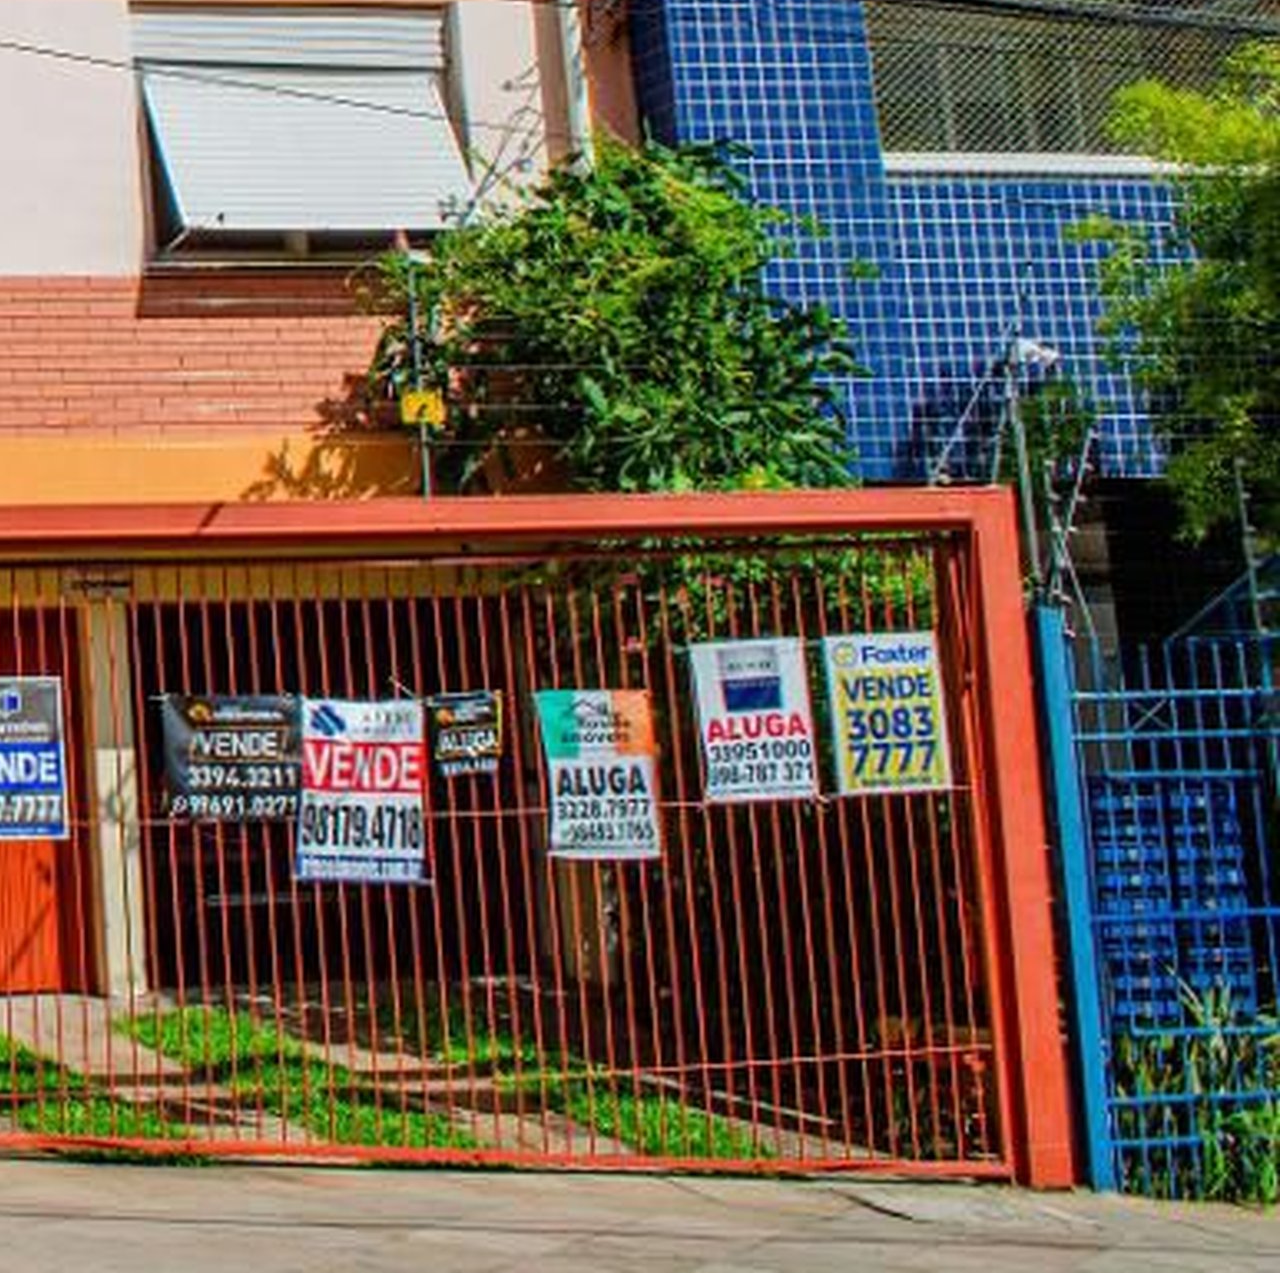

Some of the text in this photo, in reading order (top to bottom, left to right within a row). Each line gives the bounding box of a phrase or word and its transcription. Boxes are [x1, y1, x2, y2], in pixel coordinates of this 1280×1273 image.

[861, 643, 932, 663] Foxter
[842, 673, 933, 703] VENDE
[707, 712, 808, 744] ALUGA
[846, 706, 935, 740] 3083
[195, 731, 278, 757] VENDE
[848, 739, 937, 776] 7777
[305, 741, 421, 789] VENDE
[557, 765, 648, 796] ALUGA
